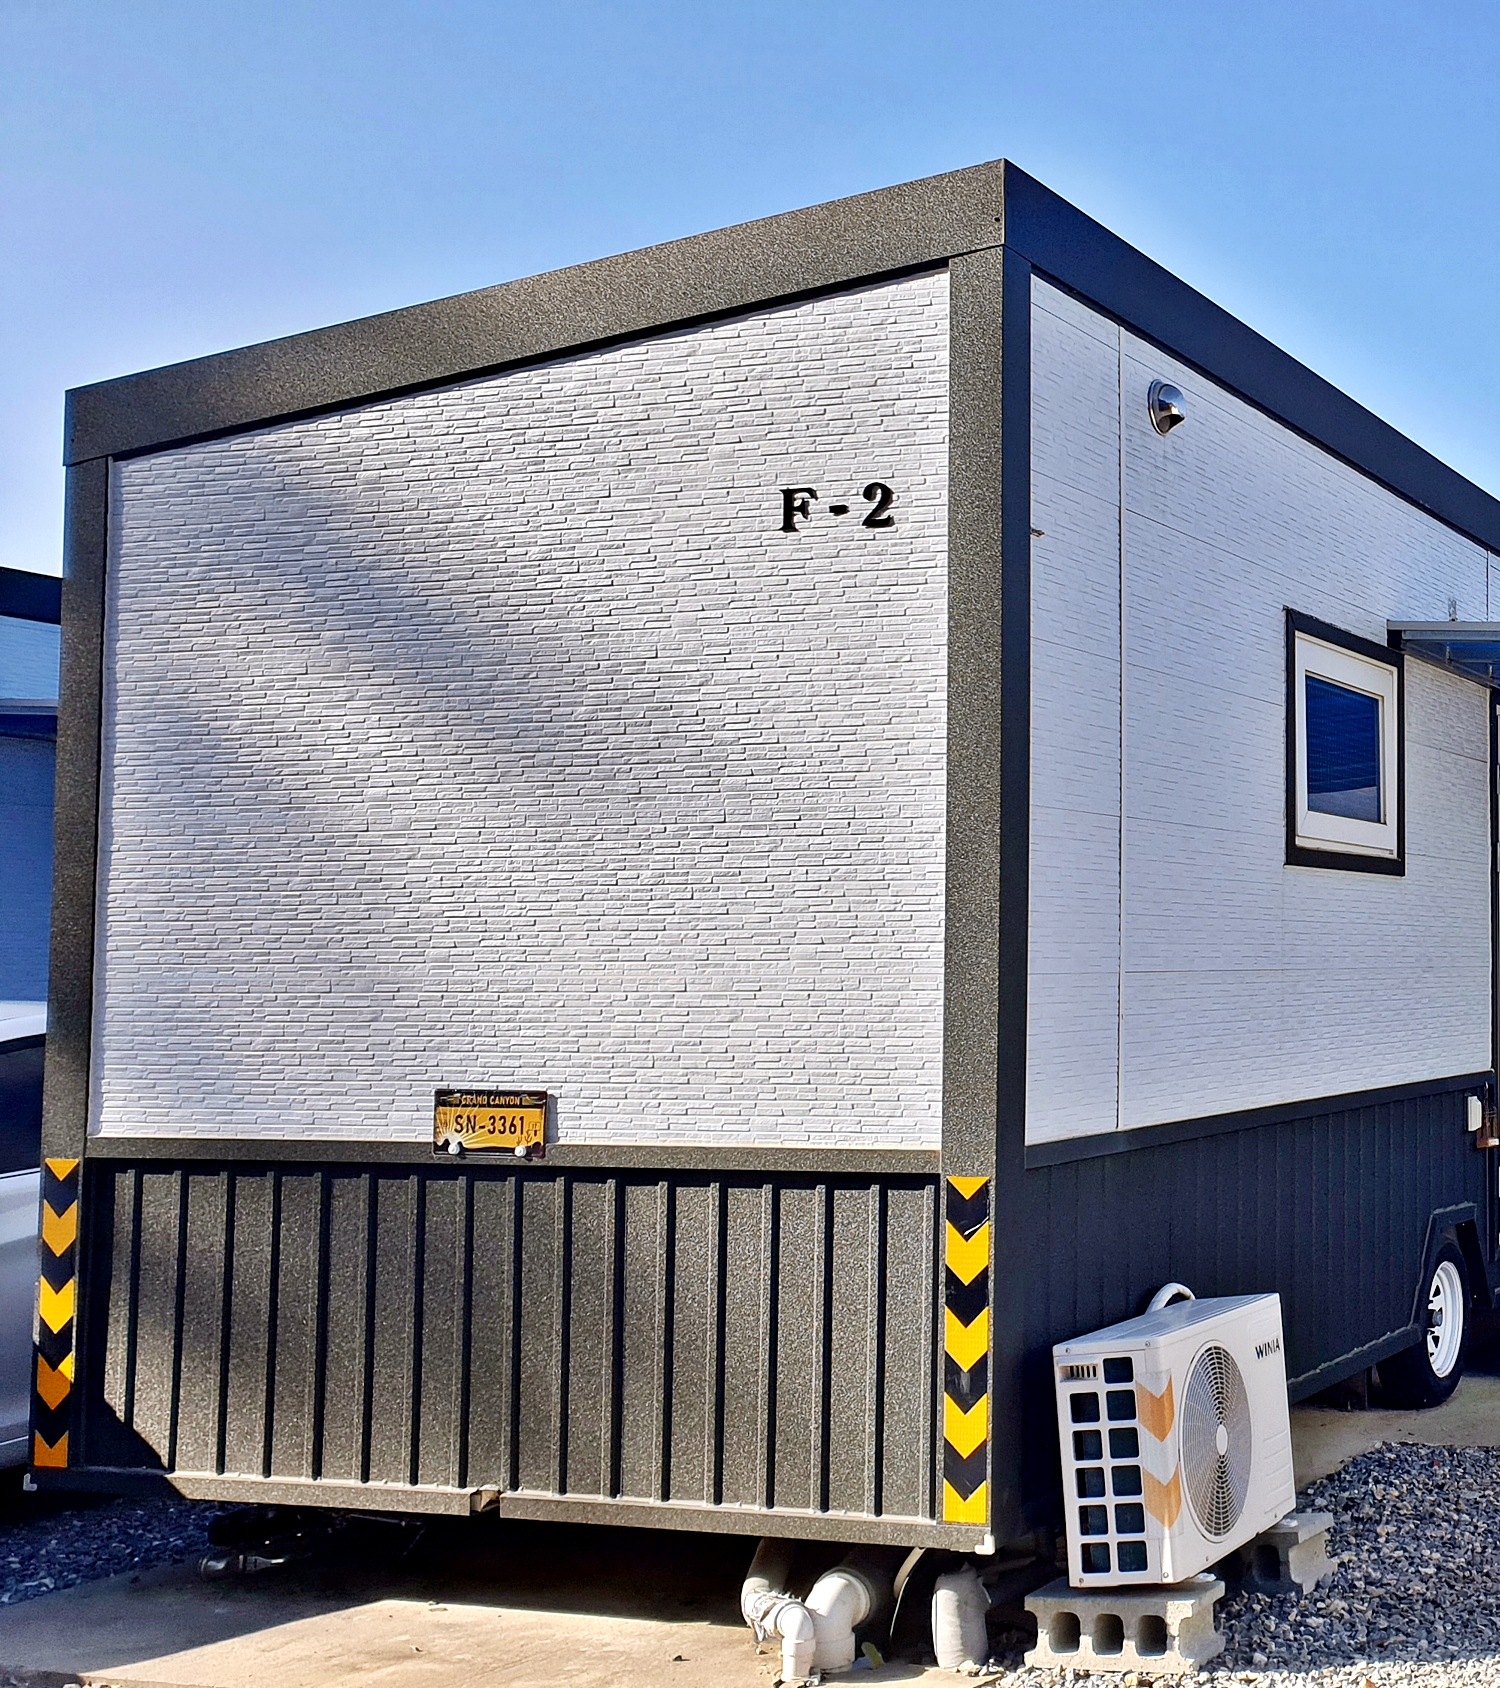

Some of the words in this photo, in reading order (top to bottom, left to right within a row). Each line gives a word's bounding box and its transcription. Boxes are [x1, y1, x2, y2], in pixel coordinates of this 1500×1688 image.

[461, 1095, 487, 1105] GRAND
[489, 1096, 520, 1105] CANYON
[454, 1114, 525, 1135] SN-3361
[1255, 1338, 1281, 1359] WINIA
